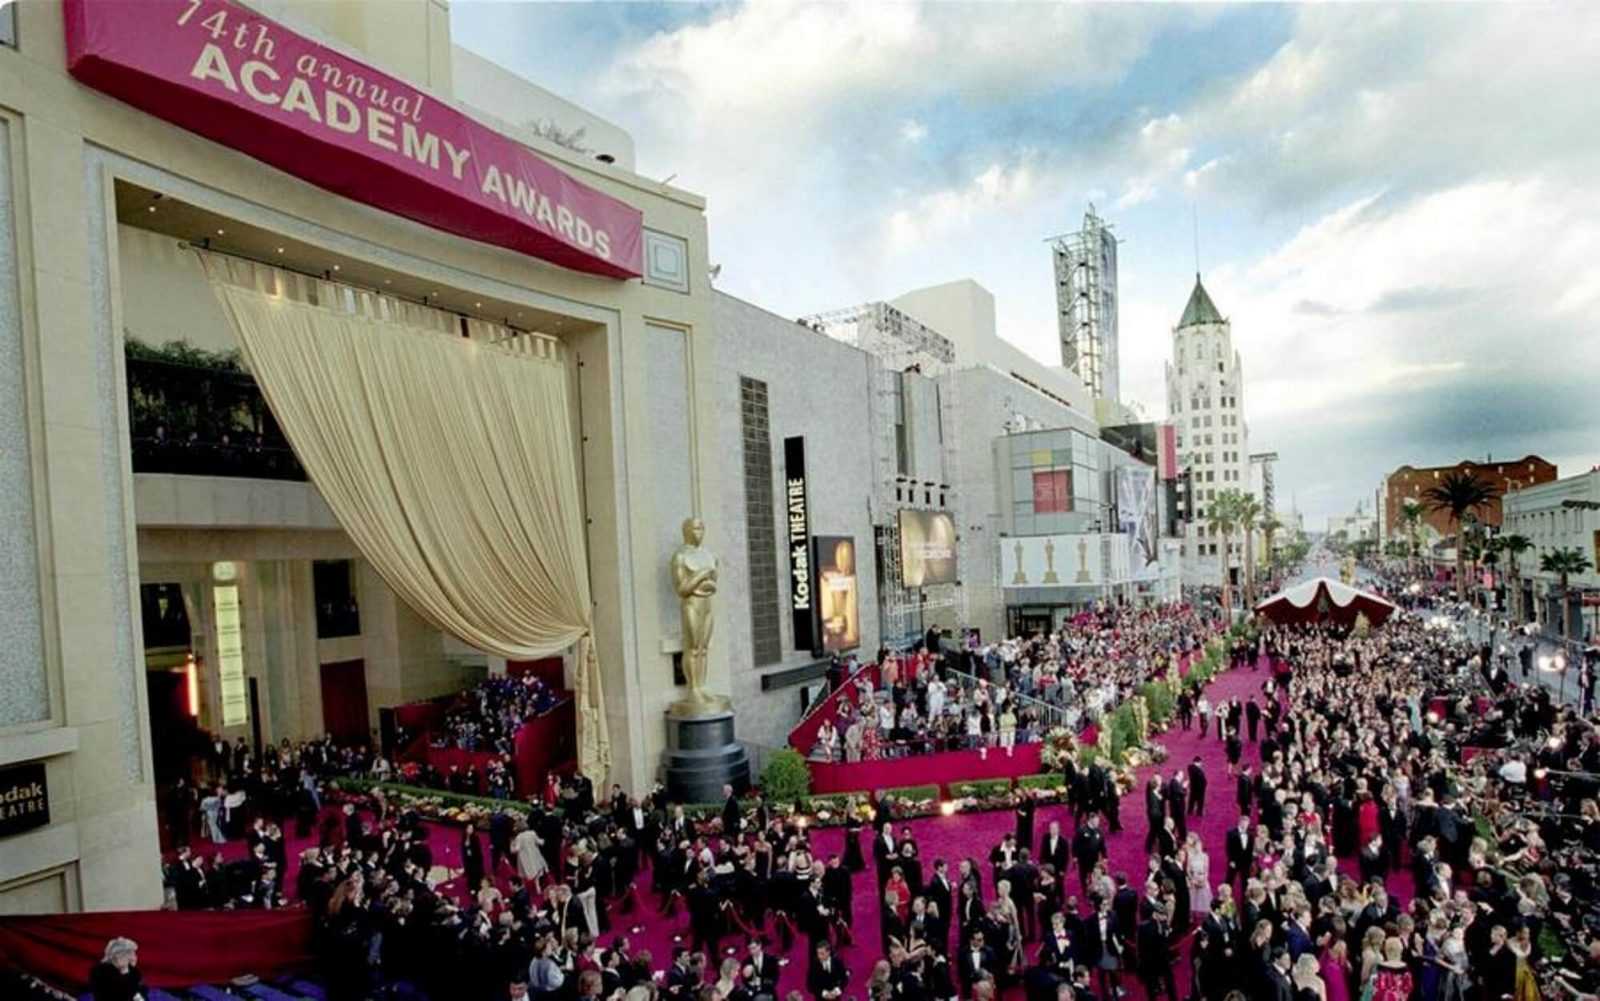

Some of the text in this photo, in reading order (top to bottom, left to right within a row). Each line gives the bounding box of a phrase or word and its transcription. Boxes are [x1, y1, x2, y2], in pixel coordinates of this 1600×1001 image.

[177, 0, 425, 123] 74th annual
[190, 42, 611, 259] ACADEMY AWARDS
[788, 478, 809, 609] Kodak THEATRE
